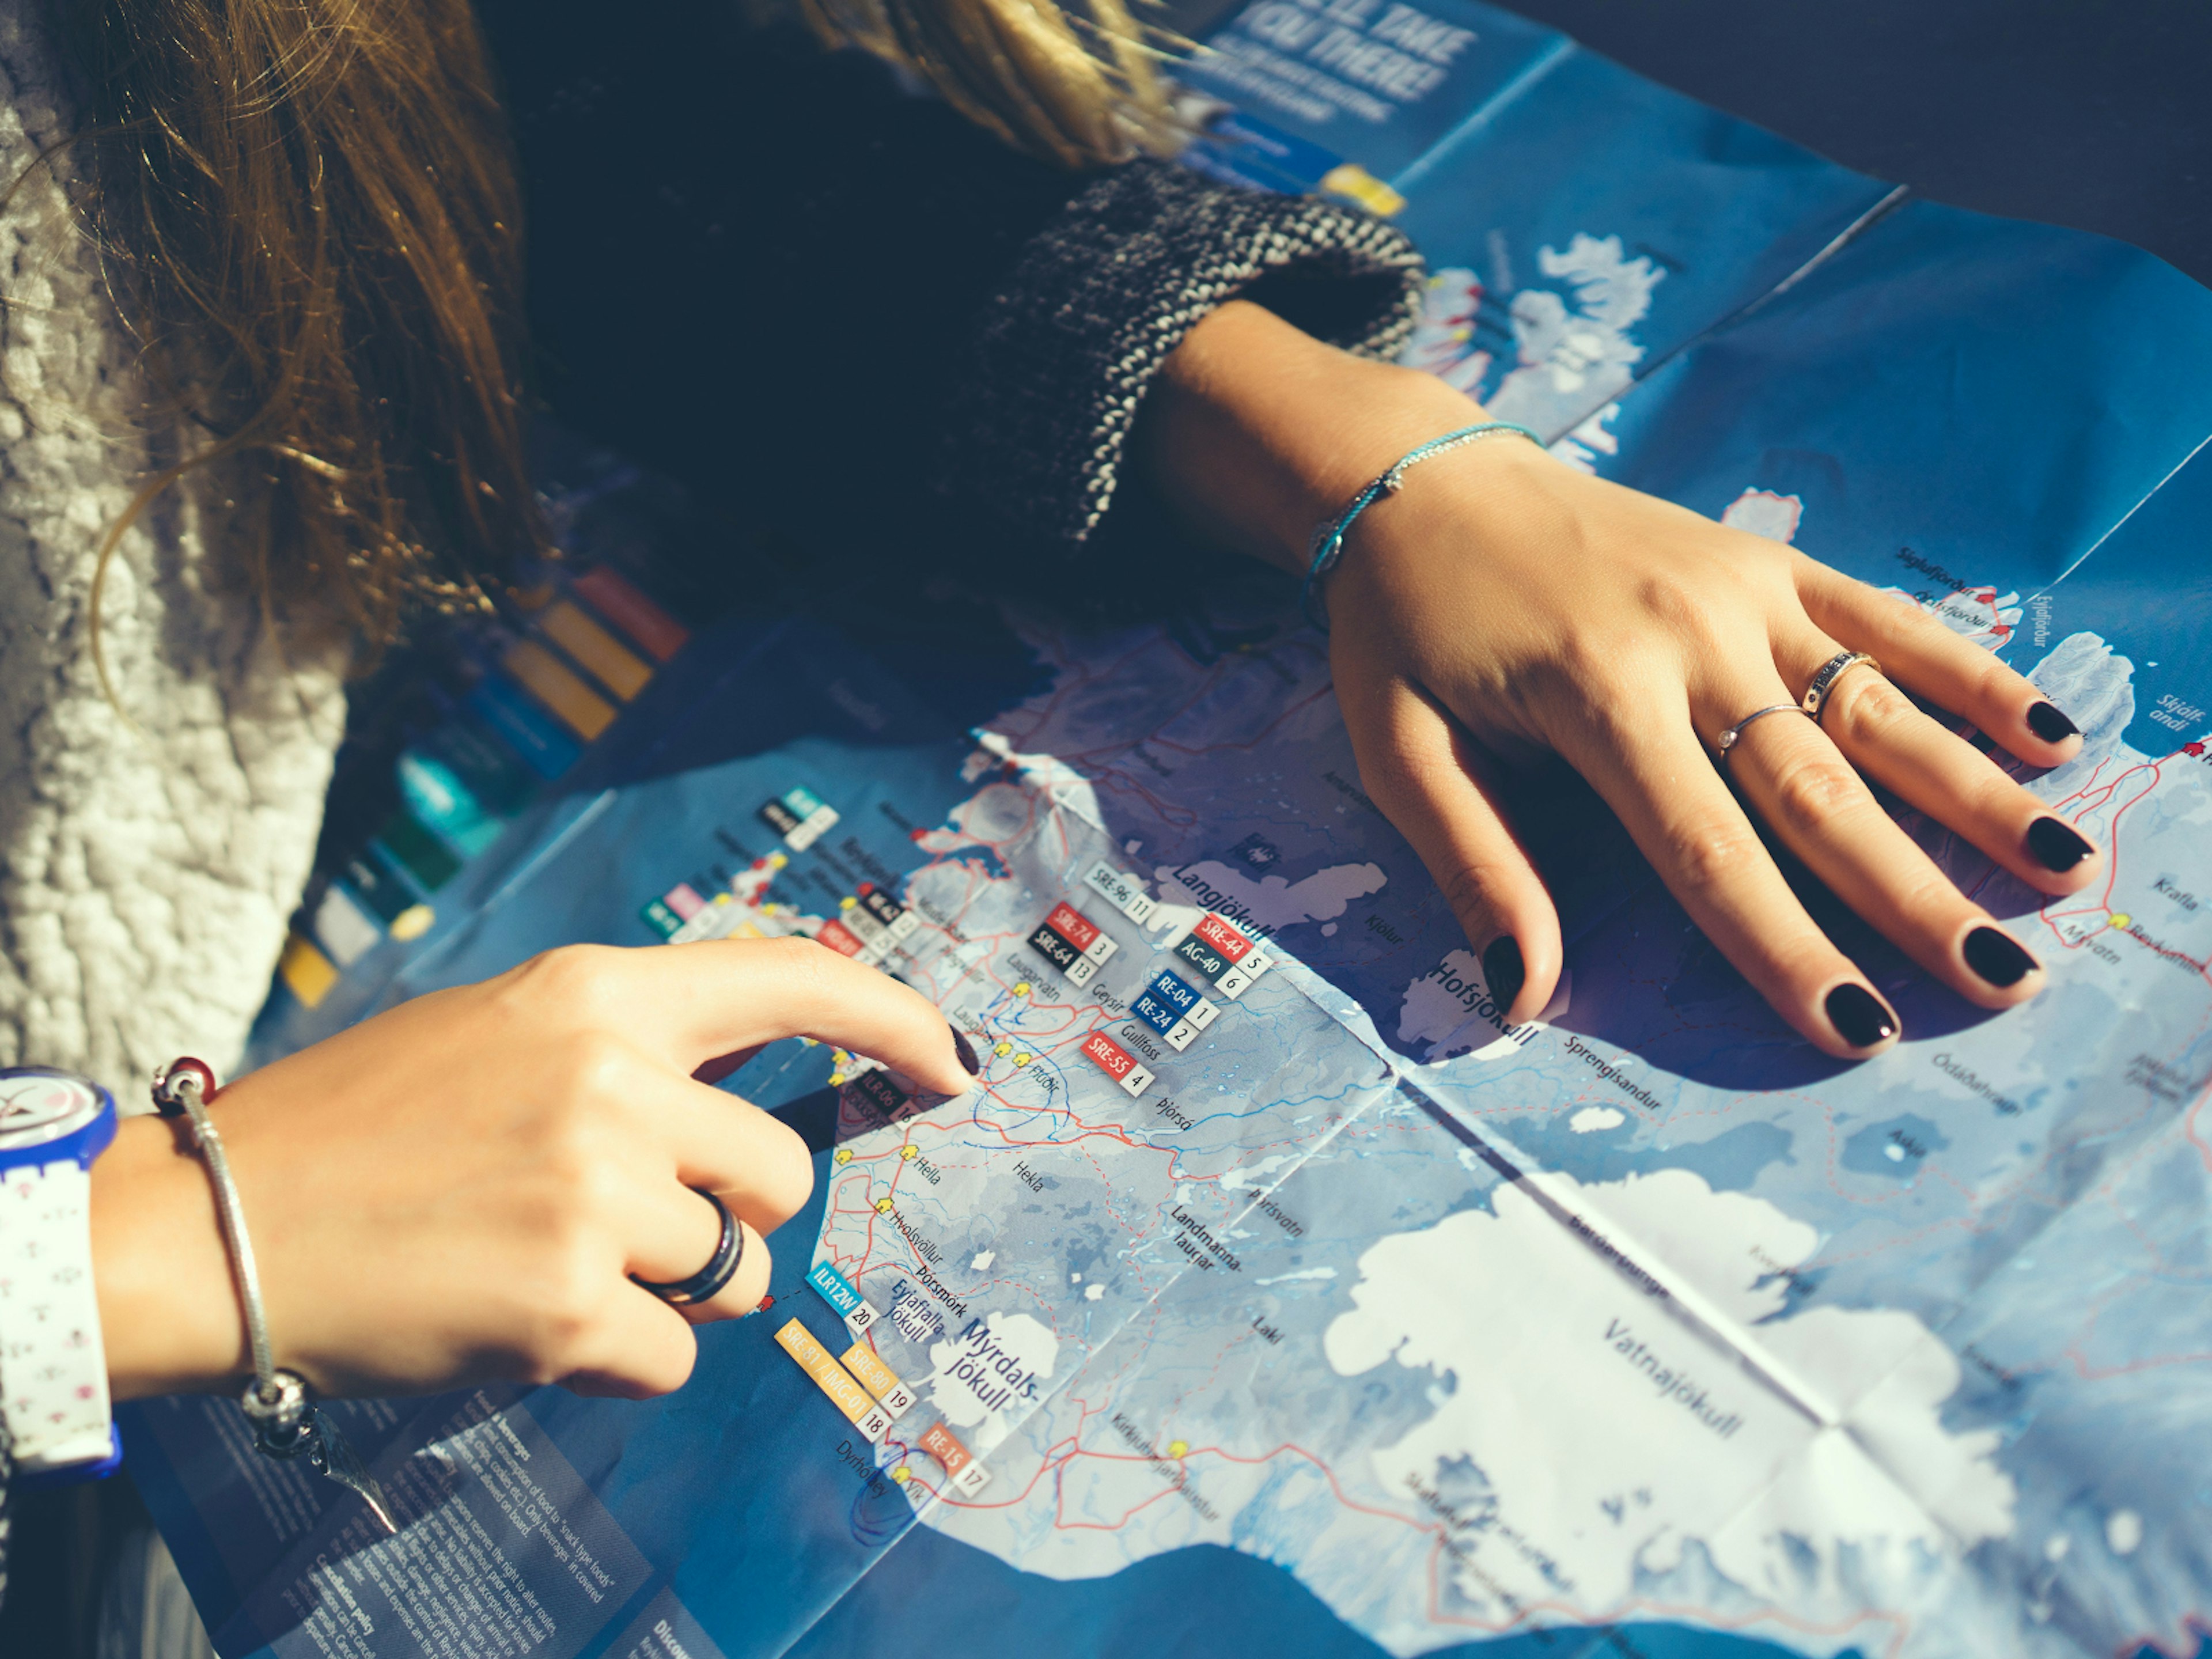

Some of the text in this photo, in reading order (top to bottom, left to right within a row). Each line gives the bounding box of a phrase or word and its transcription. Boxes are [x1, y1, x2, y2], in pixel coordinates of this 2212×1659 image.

[1092, 868, 1131, 902] SRE-96
[2152, 877, 2199, 912] Krafla
[1132, 900, 1150, 917] 11
[1171, 863, 1280, 945] Langjökull
[1054, 907, 1093, 944] SRE-74
[1200, 919, 1245, 957] SRE-44
[1034, 931, 1073, 965] SRE-64
[1094, 943, 1107, 956] 3
[1181, 941, 1222, 974] AG-40
[1247, 957, 1260, 971] 5
[1006, 953, 1062, 1003] Laugarvatn
[1073, 962, 1091, 980] 13
[1225, 977, 1238, 990] 6
[1092, 983, 1124, 1014] Geysir
[1157, 976, 1193, 1008] RE-04
[1137, 995, 1173, 1029] RE-24
[1198, 1007, 1207, 1021] 1
[1121, 1024, 1162, 1062] Gullfoss
[1175, 1028, 1188, 1043] 2
[1088, 1037, 1130, 1075] SRE-55
[1563, 1035, 1664, 1112] Sprengisandur
[863, 1075, 895, 1111] ILR-06
[1131, 1075, 1143, 1088] 4
[897, 1107, 914, 1123] 16
[913, 1157, 942, 1186] Hella
[1012, 1161, 1044, 1194] Hekla
[889, 1211, 943, 1266] Hvolsvöllur
[1170, 1205, 1244, 1274] Landmanna-
[1173, 1232, 1216, 1272] laugar
[813, 1267, 857, 1311] ILR12W
[915, 1265, 968, 1319] Þórsmörk
[851, 1308, 871, 1325] 20
[883, 1306, 927, 1343] jökull
[1252, 1316, 1286, 1346] Laki
[783, 1326, 823, 1366] SRE-81
[824, 1369, 868, 1416] IMG-01
[849, 1349, 890, 1391] SRE-80
[960, 1317, 1041, 1403] Mýrdals-
[1601, 1317, 1745, 1440] Vatnajökull
[889, 1389, 908, 1408] 19
[944, 1351, 1012, 1413] jökull
[498, 1419, 531, 1461] beverages
[865, 1415, 885, 1434] 18
[927, 1430, 965, 1467] RE-15
[963, 1468, 983, 1487] 17
[471, 1462, 483, 1475] are
[480, 1474, 505, 1502] allowed
[501, 1500, 512, 1513] on
[509, 1509, 531, 1538] board.
[496, 1442, 532, 1488] consumption
[529, 1486, 541, 1497] of
[536, 1493, 555, 1514] food
[550, 1511, 560, 1524] to
[575, 1544, 592, 1565] type
[491, 1461, 512, 1488] cookies
[525, 1504, 542, 1526] Only
[540, 1523, 569, 1562] beverages
[568, 1559, 578, 1574] in
[575, 1571, 604, 1603] covered
[388, 1540, 460, 1642] strikes, damage, negligence,
[401, 1530, 486, 1649] of flights or other services, injury,
[417, 1527, 431, 1543] due
[429, 1540, 438, 1552] to
[435, 1551, 454, 1576] delays
[452, 1574, 462, 1585] or
[459, 1584, 483, 1615] changes
[480, 1614, 493, 1624] of
[487, 1623, 510, 1647] arrival
[505, 1646, 514, 1657] or
[431, 1519, 446, 1540] arise.
[445, 1536, 456, 1552] No
[455, 1549, 476, 1579] liability
[474, 1574, 482, 1586] is
[478, 1584, 507, 1619] accepted
[503, 1615, 516, 1630] for
[512, 1627, 531, 1654] losses
[440, 1505, 546, 1643] timetables without prior notice, should
[470, 1520, 494, 1550] reserves
[492, 1547, 504, 1564] the
[502, 1562, 520, 1582] right
[516, 1579, 525, 1592] to
[522, 1590, 539, 1608] alter
[536, 1608, 556, 1637] routes,
[317, 1554, 374, 1635] Cancellation policy
[363, 1556, 382, 1582] losses
[378, 1580, 394, 1597] and
[389, 1596, 415, 1629] expenses
[411, 1627, 423, 1642] are
[421, 1639, 433, 1656] the
[387, 1563, 408, 1591] outside
[405, 1589, 418, 1604] the
[414, 1603, 437, 1631] control
[432, 1630, 444, 1640] of
[302, 1617, 330, 1654] departure
[337, 1611, 350, 1627] can
[346, 1623, 357, 1638] be
